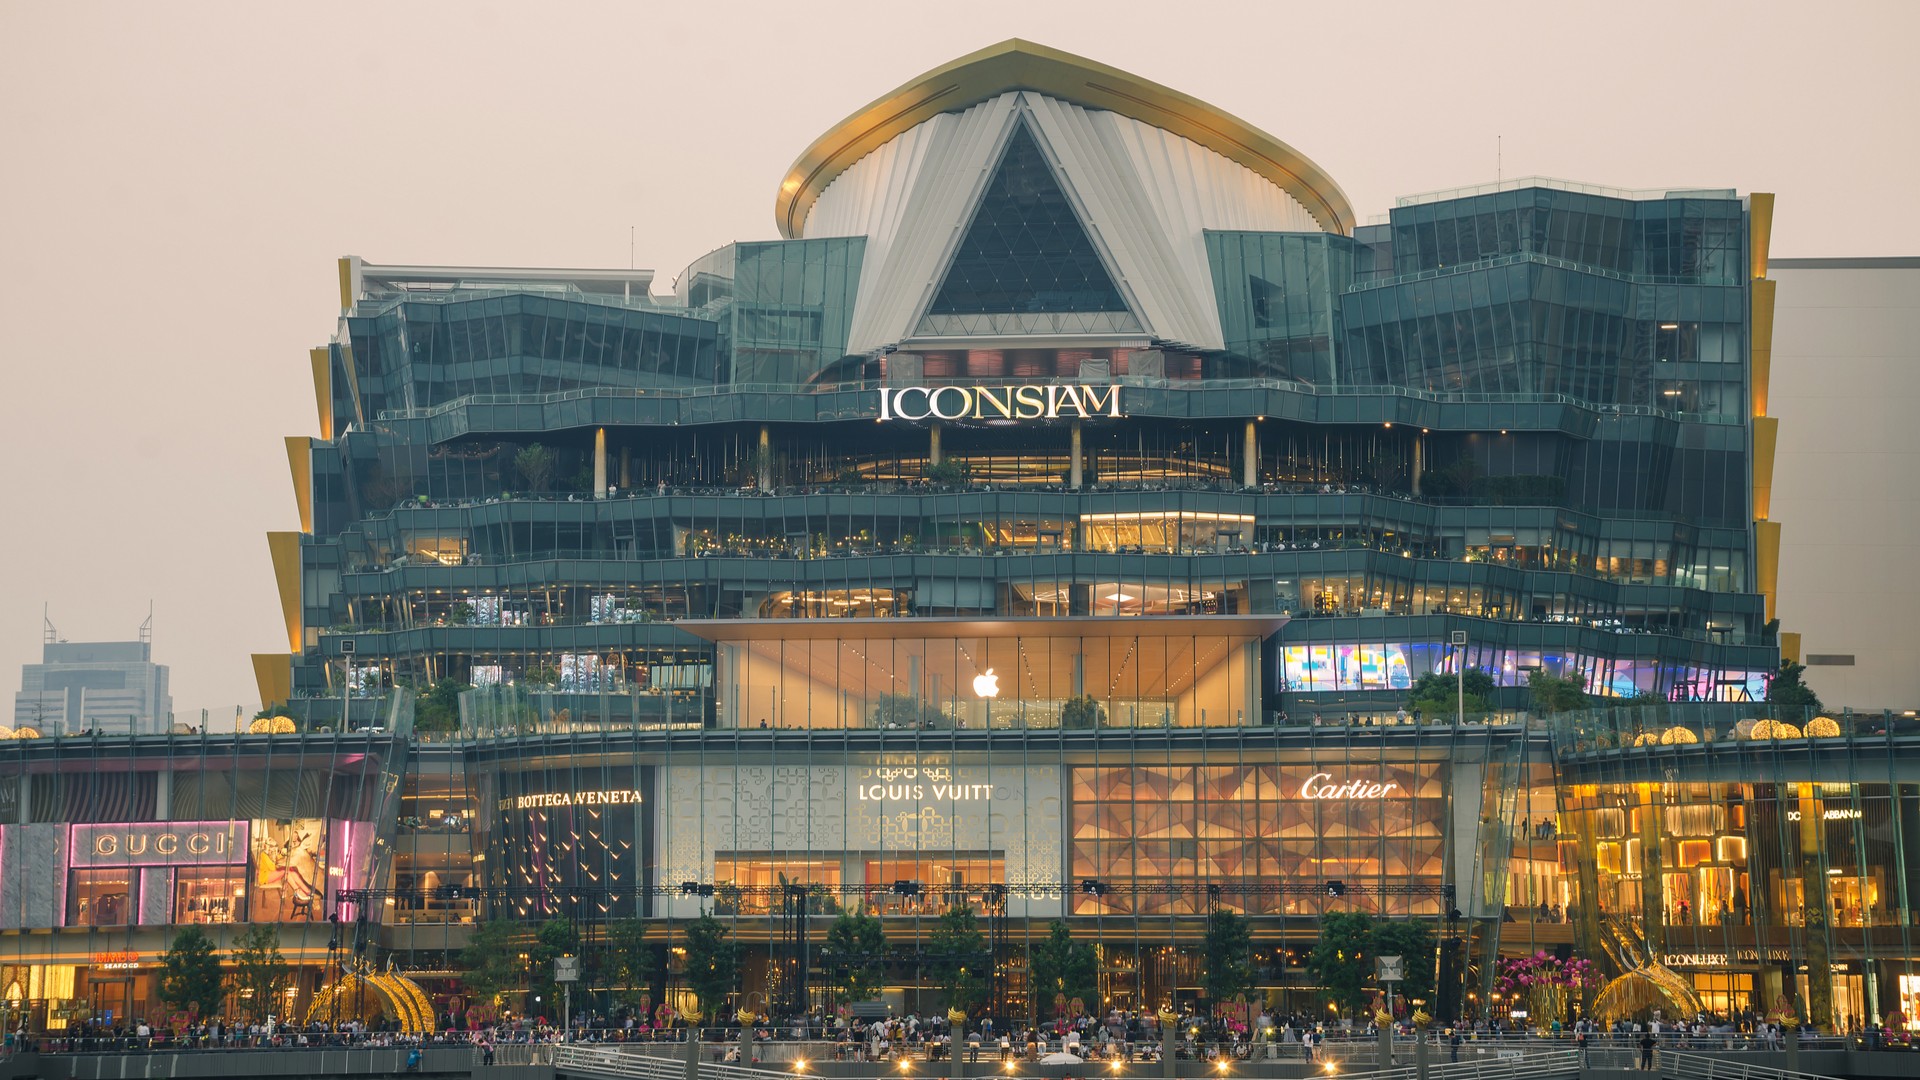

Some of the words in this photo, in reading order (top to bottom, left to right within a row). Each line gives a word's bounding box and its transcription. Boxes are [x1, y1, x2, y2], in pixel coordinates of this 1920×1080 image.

[877, 384, 1124, 421] ICONSIAM
[859, 784, 924, 801] LOUIS
[1301, 772, 1397, 799] Cartier
[517, 792, 572, 809] BOTTEGA
[574, 790, 643, 806] VENETA
[95, 832, 225, 856] GUCCI
